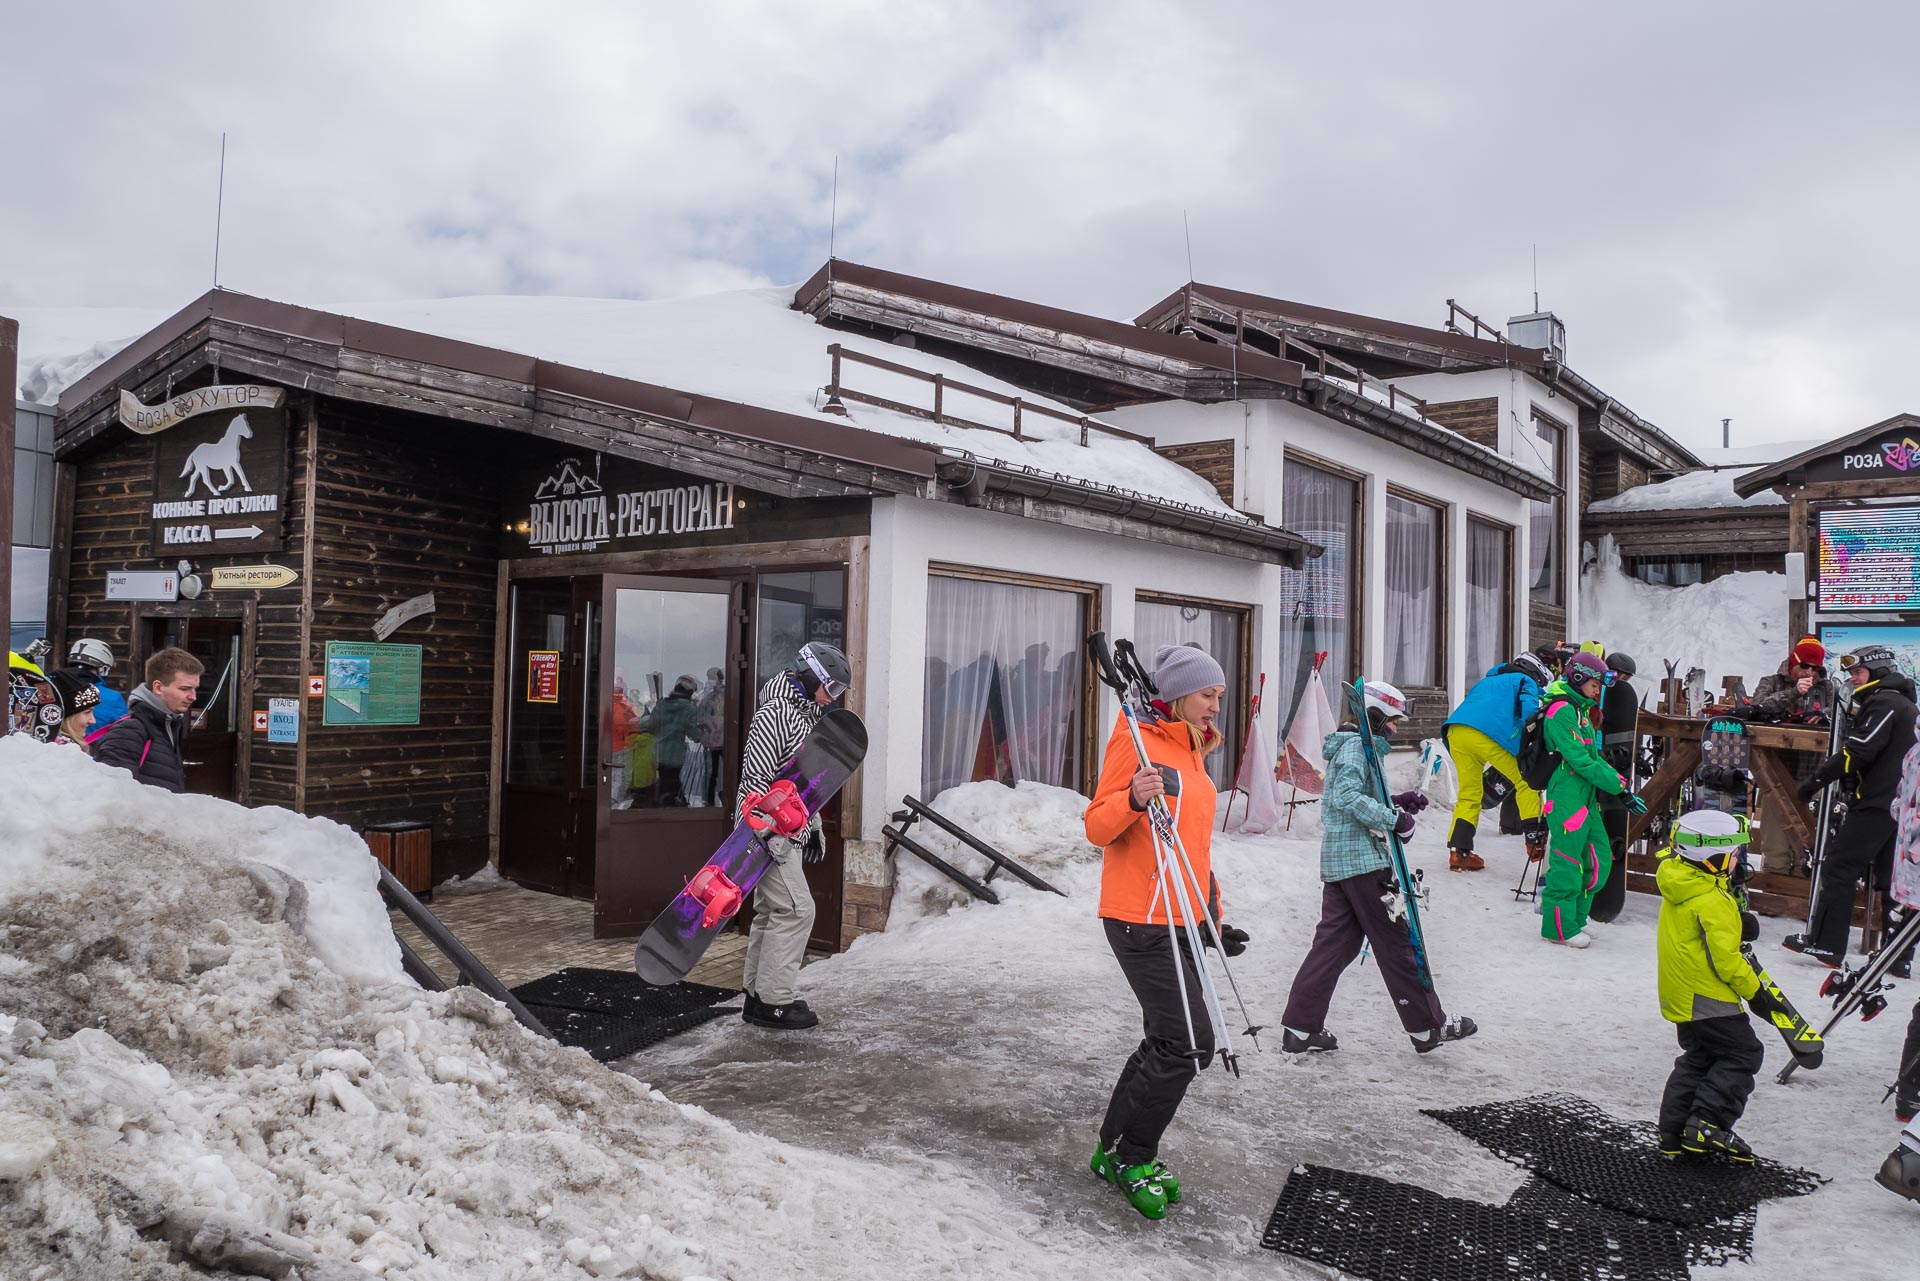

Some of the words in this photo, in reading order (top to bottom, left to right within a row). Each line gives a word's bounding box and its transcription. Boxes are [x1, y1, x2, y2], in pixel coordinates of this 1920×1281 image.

[136, 408, 171, 428] РОЗА
[196, 386, 260, 407] ХУТОР
[1844, 454, 1884, 470] РОЗА
[152, 500, 206, 518] КОННЫЕ
[208, 494, 278, 515] ПРОГУЛКИ
[528, 496, 610, 544] ВЫСОТА
[616, 482, 734, 538] РЕСТОРАН
[164, 524, 212, 544] КАССА
[218, 570, 246, 580] Уютный
[248, 571, 282, 580] ресторан
[1864, 652, 1891, 662] uvex
[273, 699, 296, 707] ТУАЛЕТ
[274, 715, 294, 724] ВХОД
